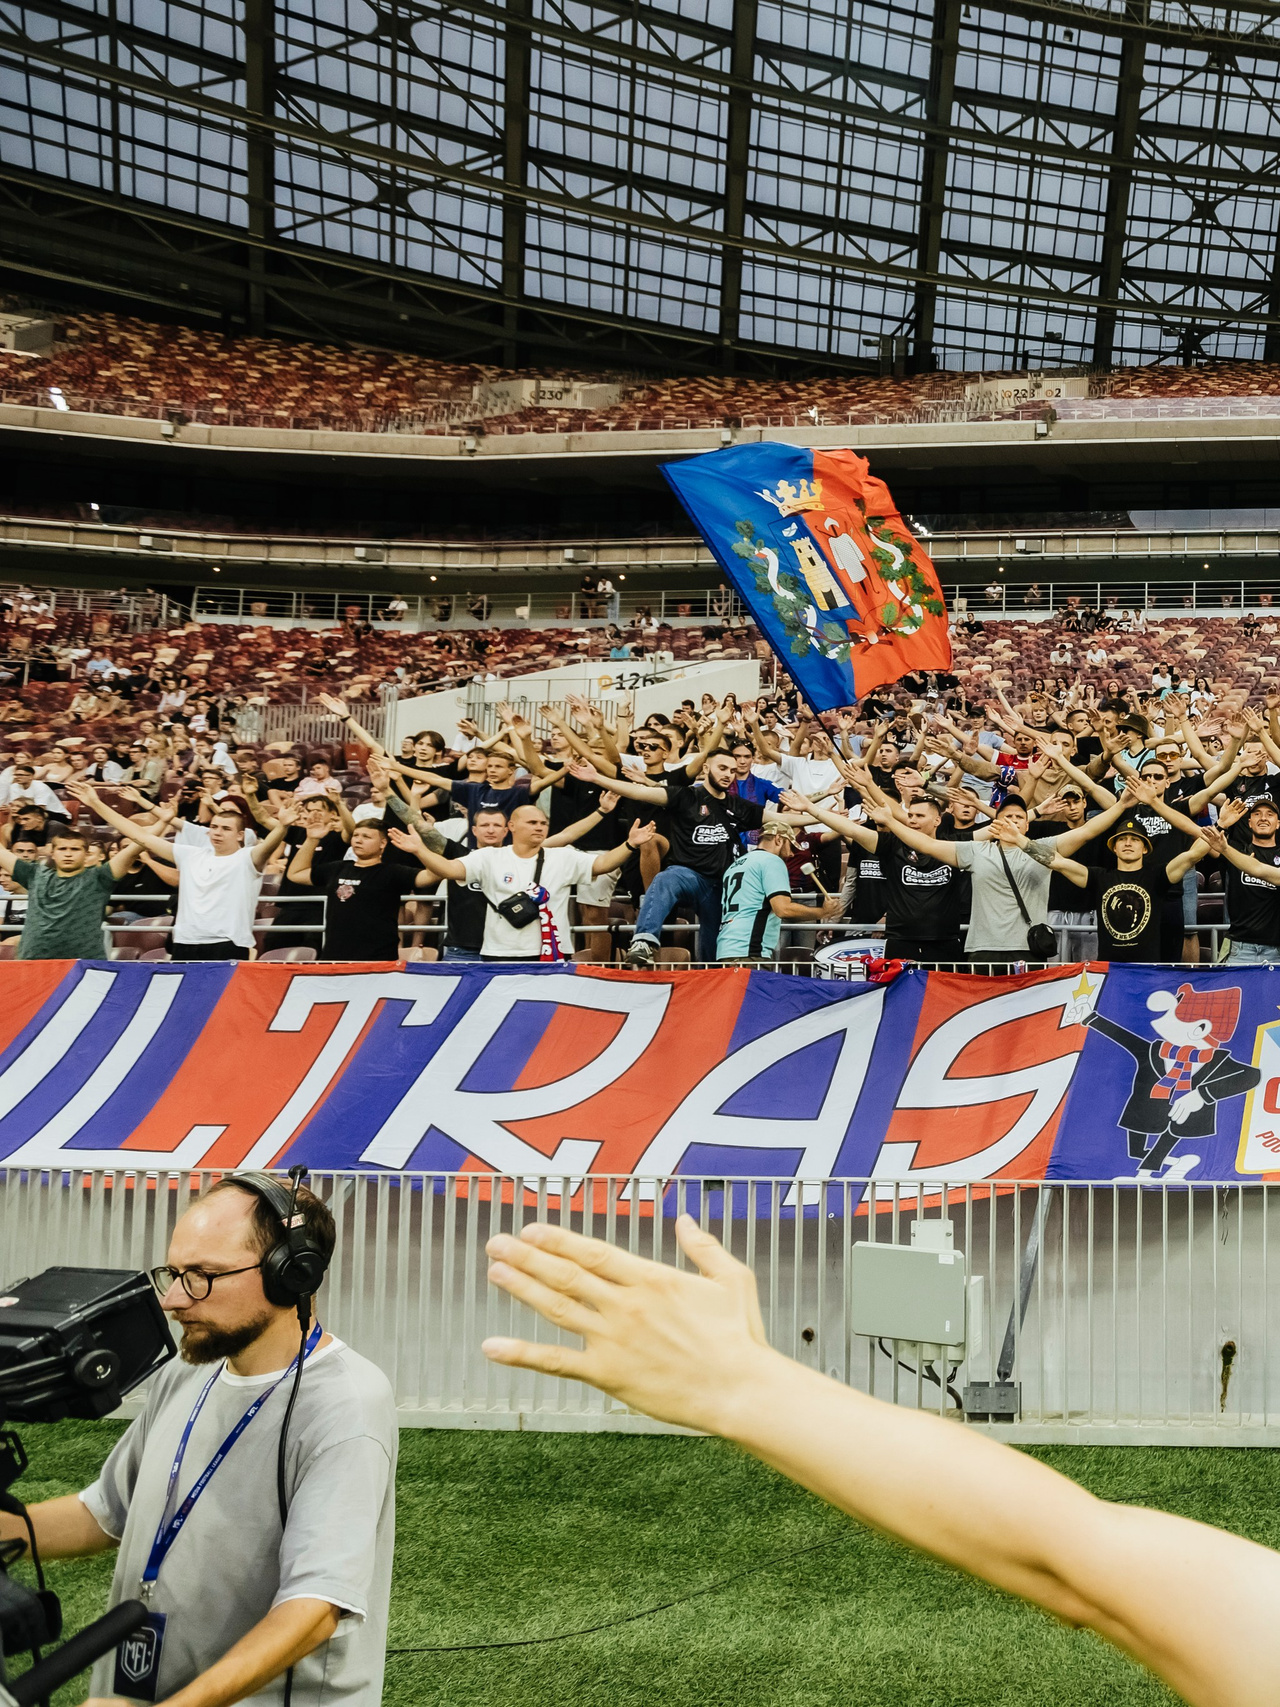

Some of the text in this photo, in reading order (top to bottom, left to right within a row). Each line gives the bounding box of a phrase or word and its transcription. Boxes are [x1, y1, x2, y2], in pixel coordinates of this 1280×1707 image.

[540, 390, 563, 400] 230
[723, 872, 745, 915] 12
[0, 968, 1107, 1205] ULTRAS
[191, 1486, 201, 1498] MEDIA
[199, 1468, 213, 1487] FOOTBALL
[211, 1453, 223, 1469] LEAGUE
[125, 1640, 150, 1677] MFL
